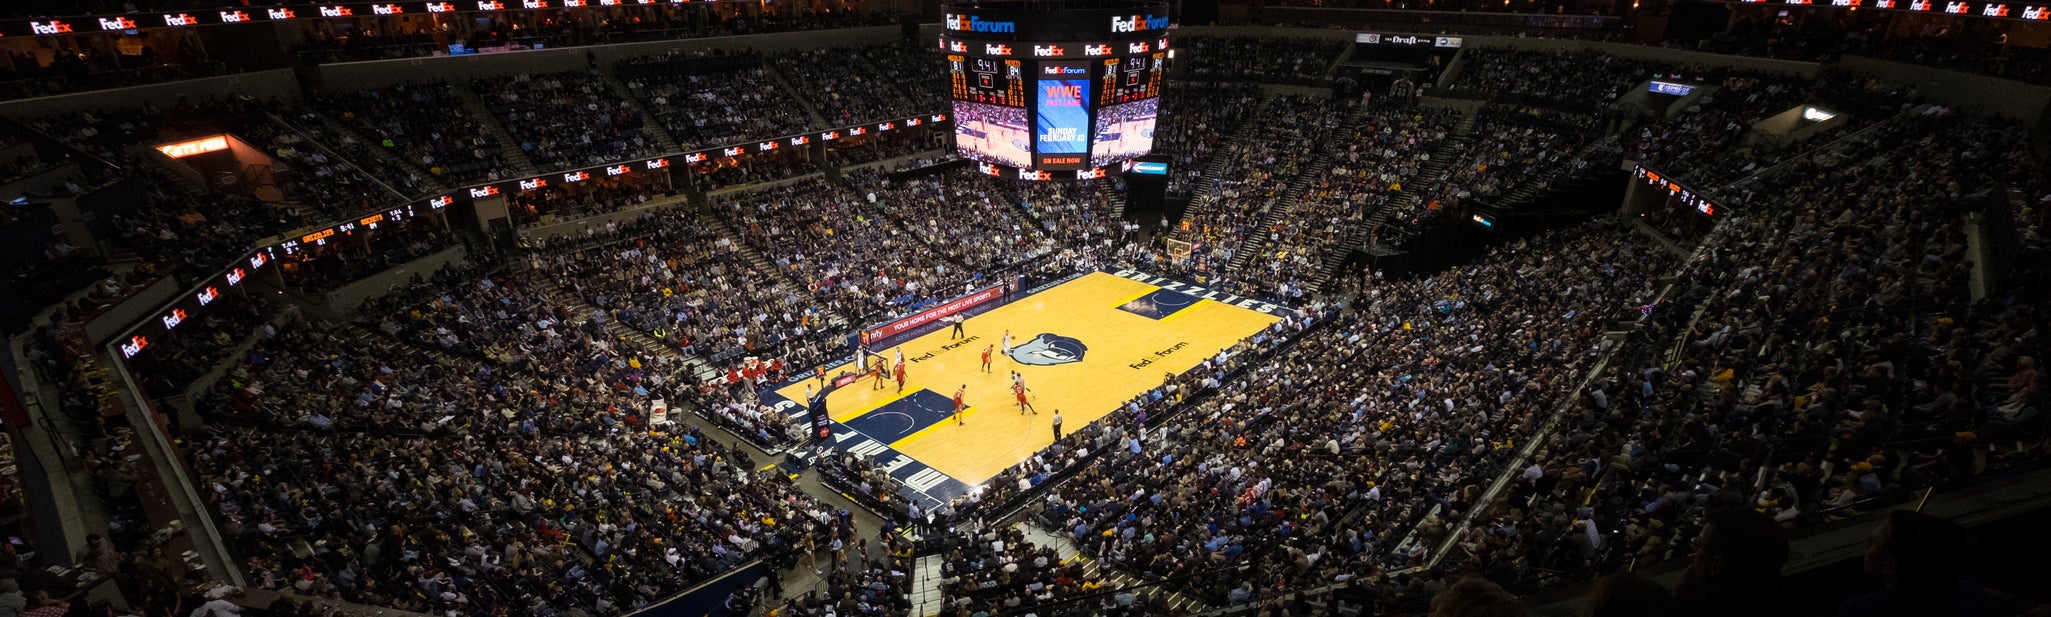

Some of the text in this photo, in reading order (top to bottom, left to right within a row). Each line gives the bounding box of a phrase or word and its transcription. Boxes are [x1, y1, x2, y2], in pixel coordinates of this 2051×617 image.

[373, 4, 403, 14] FedEx
[426, 2, 455, 12] FedEx
[478, 0, 504, 10] FedEx
[523, 0, 548, 9] FedEx
[1910, 0, 1931, 10] FedEx
[1945, 2, 1969, 13] FedEx
[1983, 4, 2009, 16] FedEx
[220, 11, 249, 22] FedEx
[268, 8, 295, 19] FedEx
[320, 6, 352, 16] FedEx
[2022, 6, 2051, 19] FedEx
[99, 17, 136, 30] FedEx
[164, 14, 197, 26] FedEx
[947, 14, 1015, 32] FedExForum
[31, 21, 72, 34] FedEx
[1392, 35, 1416, 44] Draft
[951, 41, 967, 52] FedEx
[986, 44, 1012, 55] FedEx
[1035, 45, 1063, 56] FedEx
[1085, 45, 1112, 56] FedEx
[1130, 42, 1149, 53] FedEx
[953, 61, 962, 71] 81
[1010, 66, 1019, 76] 84
[1046, 86, 1081, 98] WWE
[907, 119, 921, 127] FedEx
[931, 114, 946, 122] FedEx
[850, 127, 866, 136] FedEx
[879, 122, 894, 131] FedEx
[1047, 127, 1077, 135] SUNDAY
[791, 136, 809, 146] FedEx
[822, 131, 839, 140] FedEx
[1040, 134, 1072, 142] FEBRUARY
[760, 141, 779, 151] FedEx
[724, 147, 744, 157] FedEx
[647, 158, 669, 169] FedEx
[685, 153, 706, 163] FedEx
[607, 165, 630, 176] FedEx
[980, 161, 1000, 176] FedEx
[1077, 167, 1106, 179] FedEx
[564, 172, 590, 183] FedEx
[1019, 169, 1051, 180] FedEx
[520, 178, 547, 190] FedEx
[470, 186, 498, 198] FedEx
[430, 195, 452, 209] FedEx
[303, 228, 334, 243] GRIZZLIES
[226, 268, 246, 286] FedEx
[197, 286, 219, 306] FedEx
[894, 321, 909, 331] YOUR
[909, 315, 925, 326] HOME
[925, 311, 937, 320] FOR
[937, 307, 947, 316] THE
[947, 302, 961, 312] MOST
[961, 298, 973, 307] LIVE
[973, 292, 991, 303] SPORTS
[163, 308, 187, 330] FedEx
[121, 336, 148, 359] FedEx
